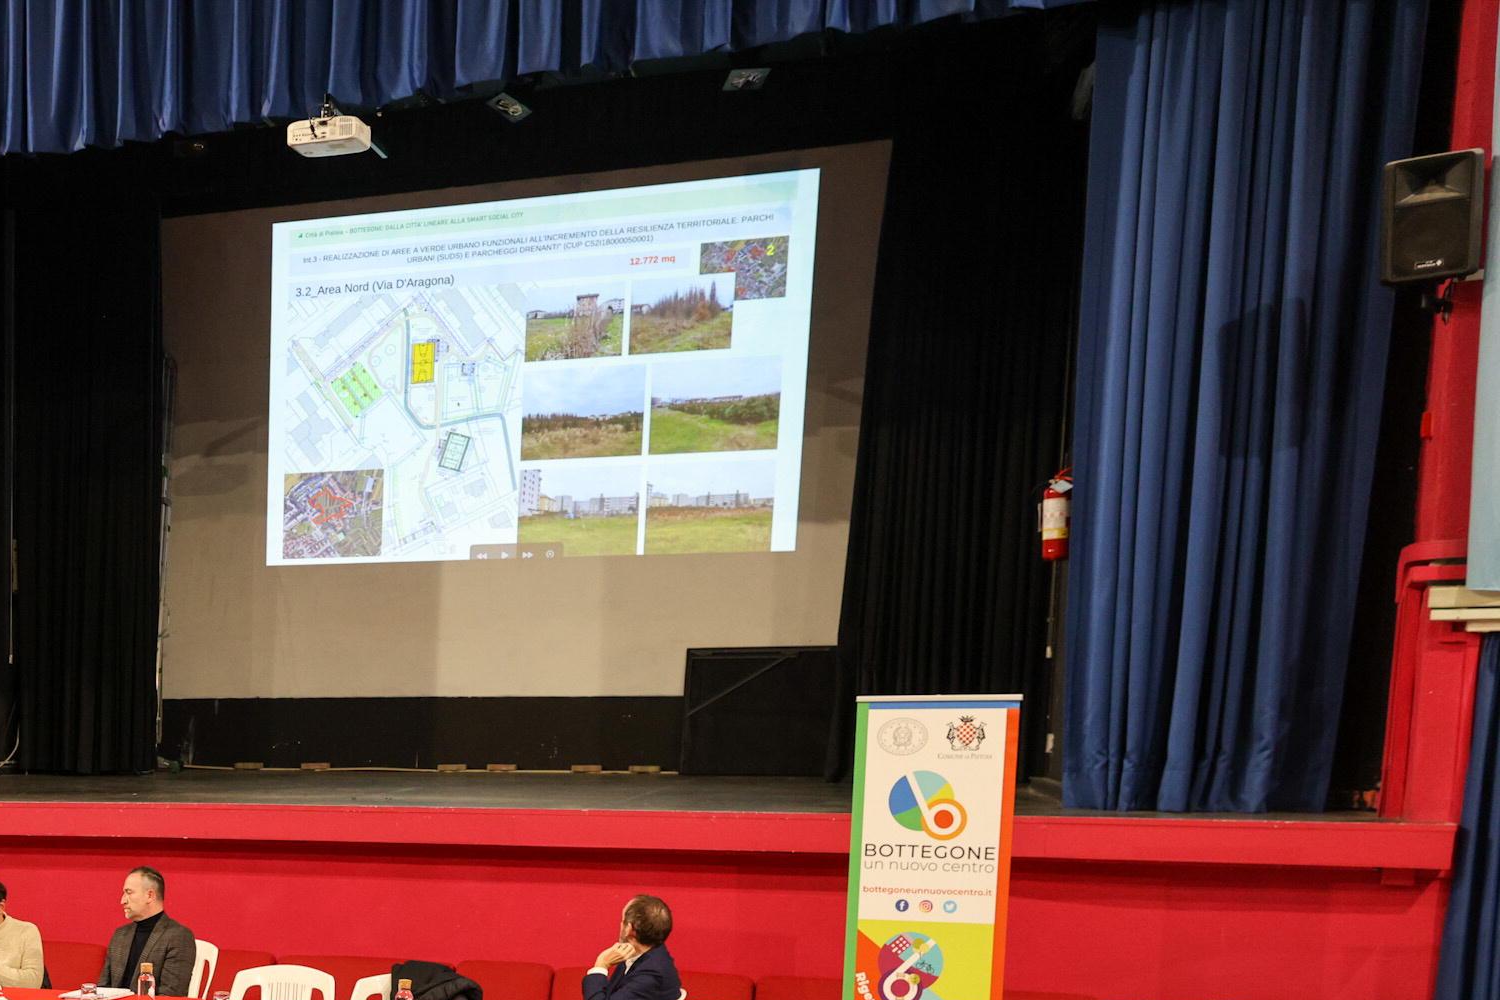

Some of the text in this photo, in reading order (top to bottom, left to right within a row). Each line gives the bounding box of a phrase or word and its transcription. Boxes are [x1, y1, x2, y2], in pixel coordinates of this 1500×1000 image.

[322, 250, 380, 262] REALIZZAZIONE
[381, 249, 390, 257] DI
[391, 247, 411, 256] AREE
[413, 246, 419, 254] A
[420, 243, 446, 253] VERDE
[447, 241, 481, 251] URBANO
[482, 236, 528, 247] FUNZIONALI
[600, 226, 625, 236] DELLA
[627, 223, 674, 233] RESILIENZA
[741, 213, 775, 224] PARCHI
[406, 254, 435, 264] URBANI
[436, 251, 463, 262] (SUDS)
[464, 250, 471, 259] E
[471, 246, 518, 258] PARCHEGGI
[766, 244, 775, 257] 2
[630, 254, 676, 266] 12.772 mq
[344, 281, 370, 293] Nord
[372, 279, 393, 293] (Via
[396, 273, 455, 289] D'Aragona)
[864, 843, 996, 861] BOTTEGONE
[863, 860, 995, 874] un nuovo centro
[862, 885, 992, 897] bottegoneunnuovocentro.it
